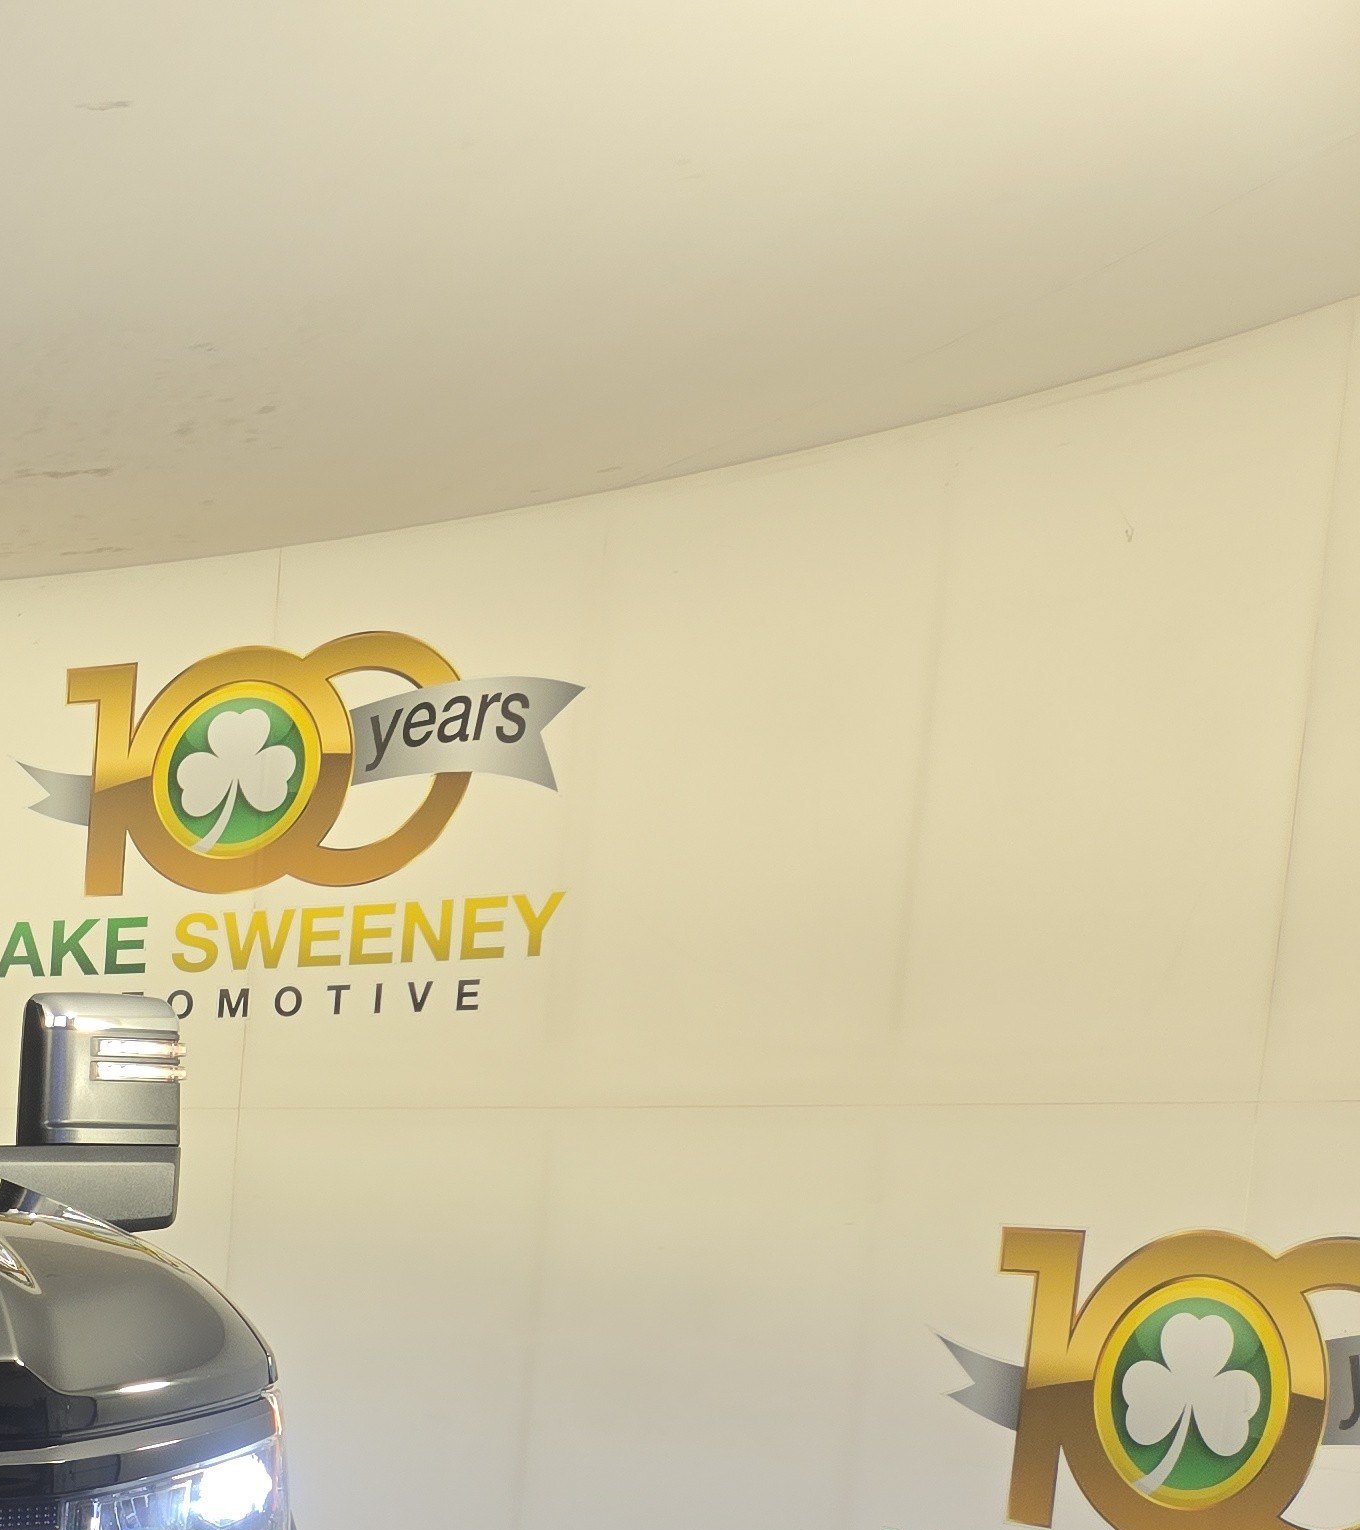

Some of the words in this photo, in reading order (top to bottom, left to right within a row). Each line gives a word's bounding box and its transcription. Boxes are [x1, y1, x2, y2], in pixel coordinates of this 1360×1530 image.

[66, 630, 476, 896] 100
[364, 690, 530, 772] years
[171, 891, 567, 974] SWEENEY
[120, 979, 481, 1021] OMOTIVE
